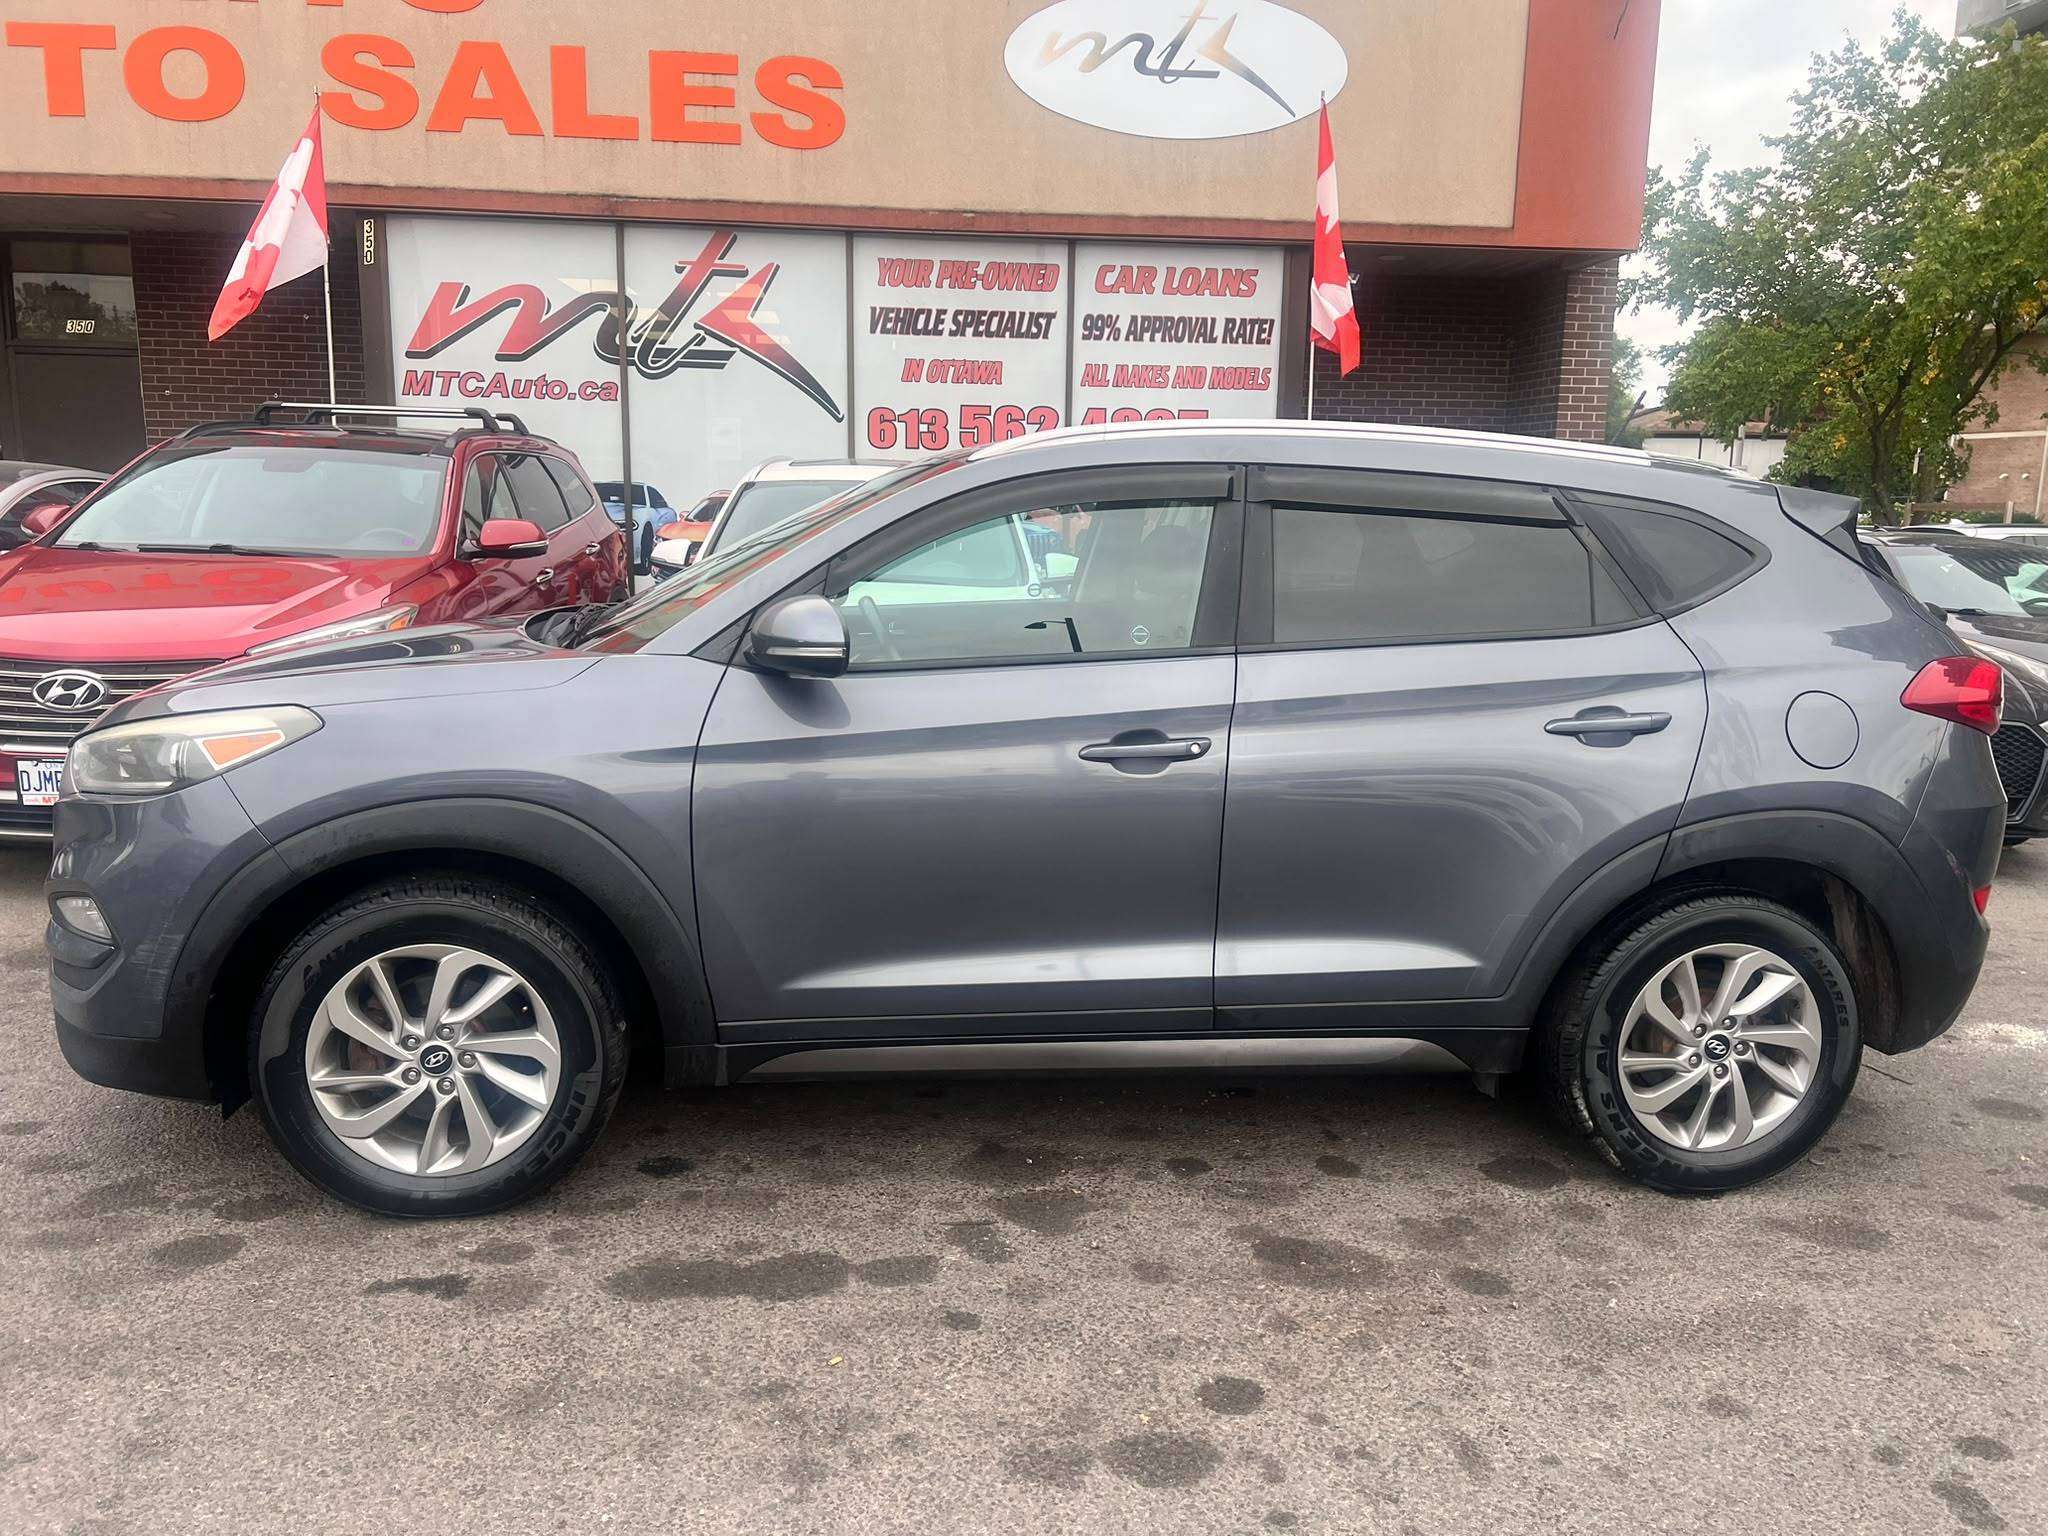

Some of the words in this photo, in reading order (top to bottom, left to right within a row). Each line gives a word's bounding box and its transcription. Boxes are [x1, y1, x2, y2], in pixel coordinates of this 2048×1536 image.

[6, 21, 245, 122] TO
[320, 33, 846, 150] SALES
[364, 219, 374, 264] 350
[877, 257, 934, 288] YOUR
[935, 259, 1060, 292] PRE-OWNED
[1094, 264, 1158, 295] CAR
[1162, 266, 1259, 298] LOANS
[66, 320, 94, 333] 350
[869, 306, 948, 337] VEHICLE
[948, 309, 1057, 340] SPECIALIST
[1081, 313, 1121, 342] 99%
[1124, 315, 1218, 344] APPROVAL
[1221, 317, 1275, 345] RATE!
[402, 370, 619, 401] MTCAuto.ca
[901, 358, 925, 383] IN
[926, 358, 1003, 385] OTTAWA
[1080, 363, 1110, 388] ALL
[1111, 364, 1171, 389] MAKES
[1171, 366, 1208, 390] AND
[1208, 366, 1272, 391] MODELS
[868, 407, 949, 450] 613
[959, 404, 1060, 448] 562
